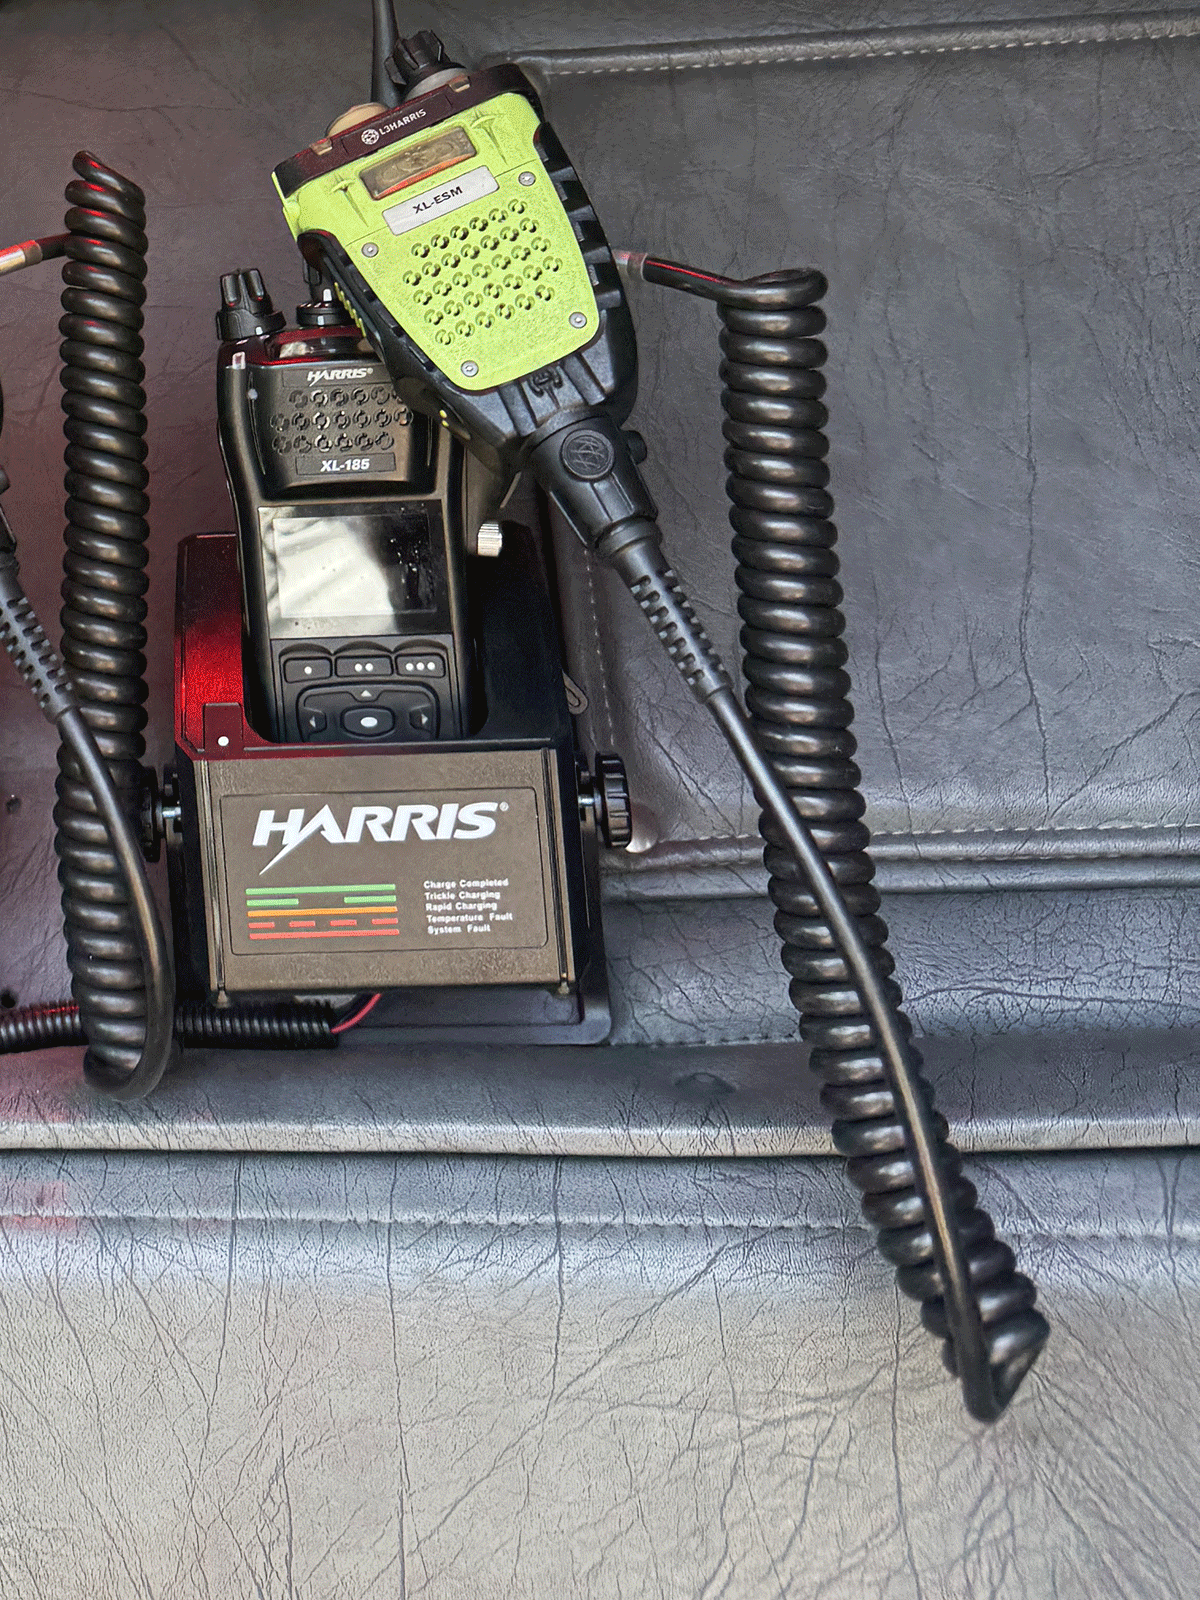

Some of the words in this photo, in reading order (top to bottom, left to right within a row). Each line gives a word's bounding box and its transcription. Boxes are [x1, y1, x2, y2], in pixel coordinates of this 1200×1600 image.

[378, 108, 427, 137] L3HARRIS
[412, 185, 463, 214] XL-ESM
[320, 458, 370, 472] XL-185
[423, 880, 456, 890] Charge
[459, 878, 509, 888] Completed
[424, 891, 456, 901] Trickle
[458, 890, 501, 900] Charging
[425, 902, 452, 912] Rapid
[455, 901, 498, 911] Charging
[426, 914, 484, 924] Temperature
[489, 912, 514, 921] Fault
[427, 925, 462, 935] System
[467, 923, 491, 933] Fault
